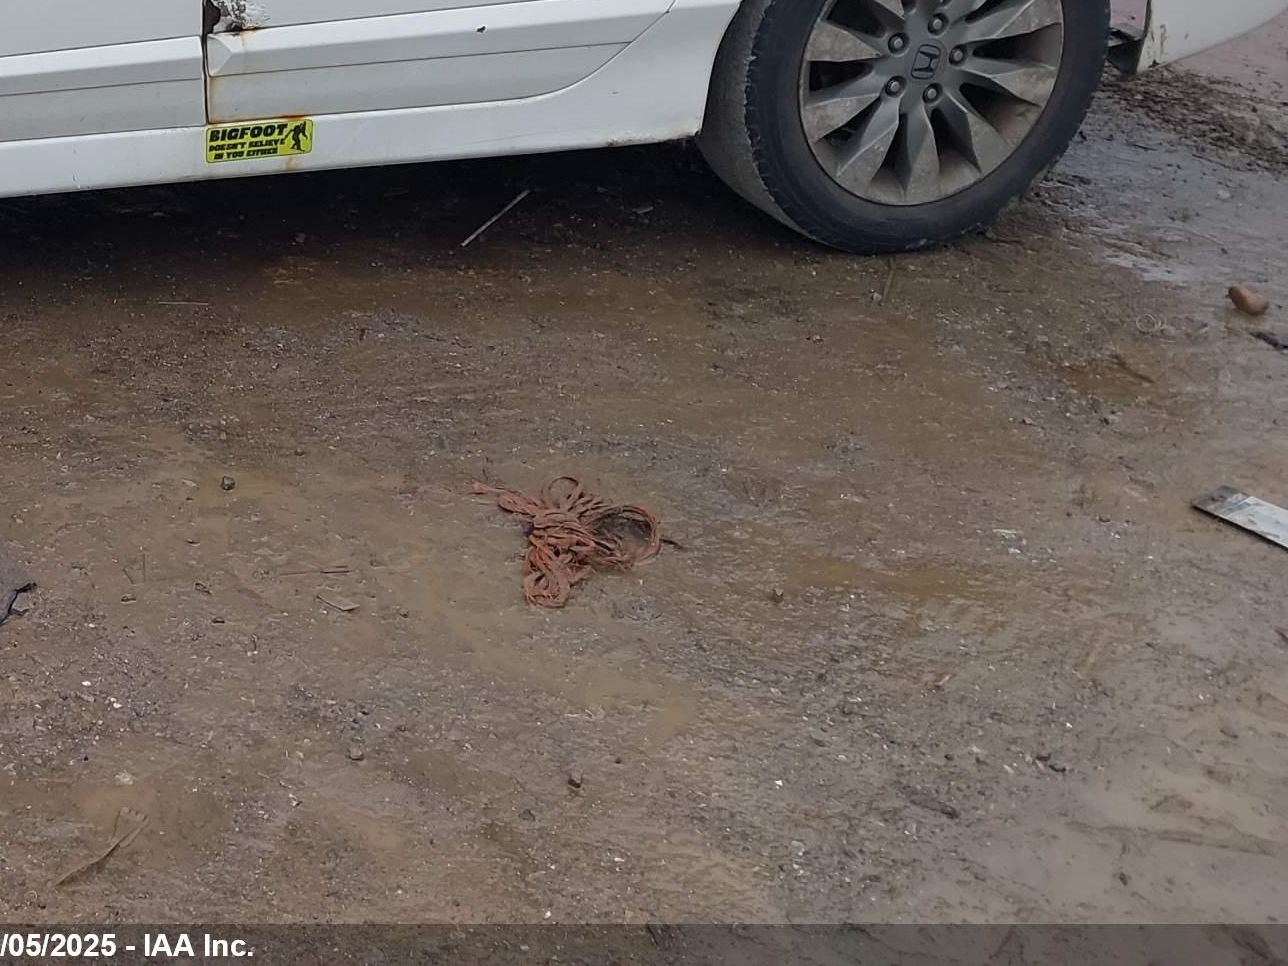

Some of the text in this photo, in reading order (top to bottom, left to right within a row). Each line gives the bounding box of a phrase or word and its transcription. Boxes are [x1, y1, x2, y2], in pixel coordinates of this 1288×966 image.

[209, 124, 288, 142] BIGFOOT
[209, 142, 247, 152] DOESN'T
[226, 150, 245, 159] YOU
